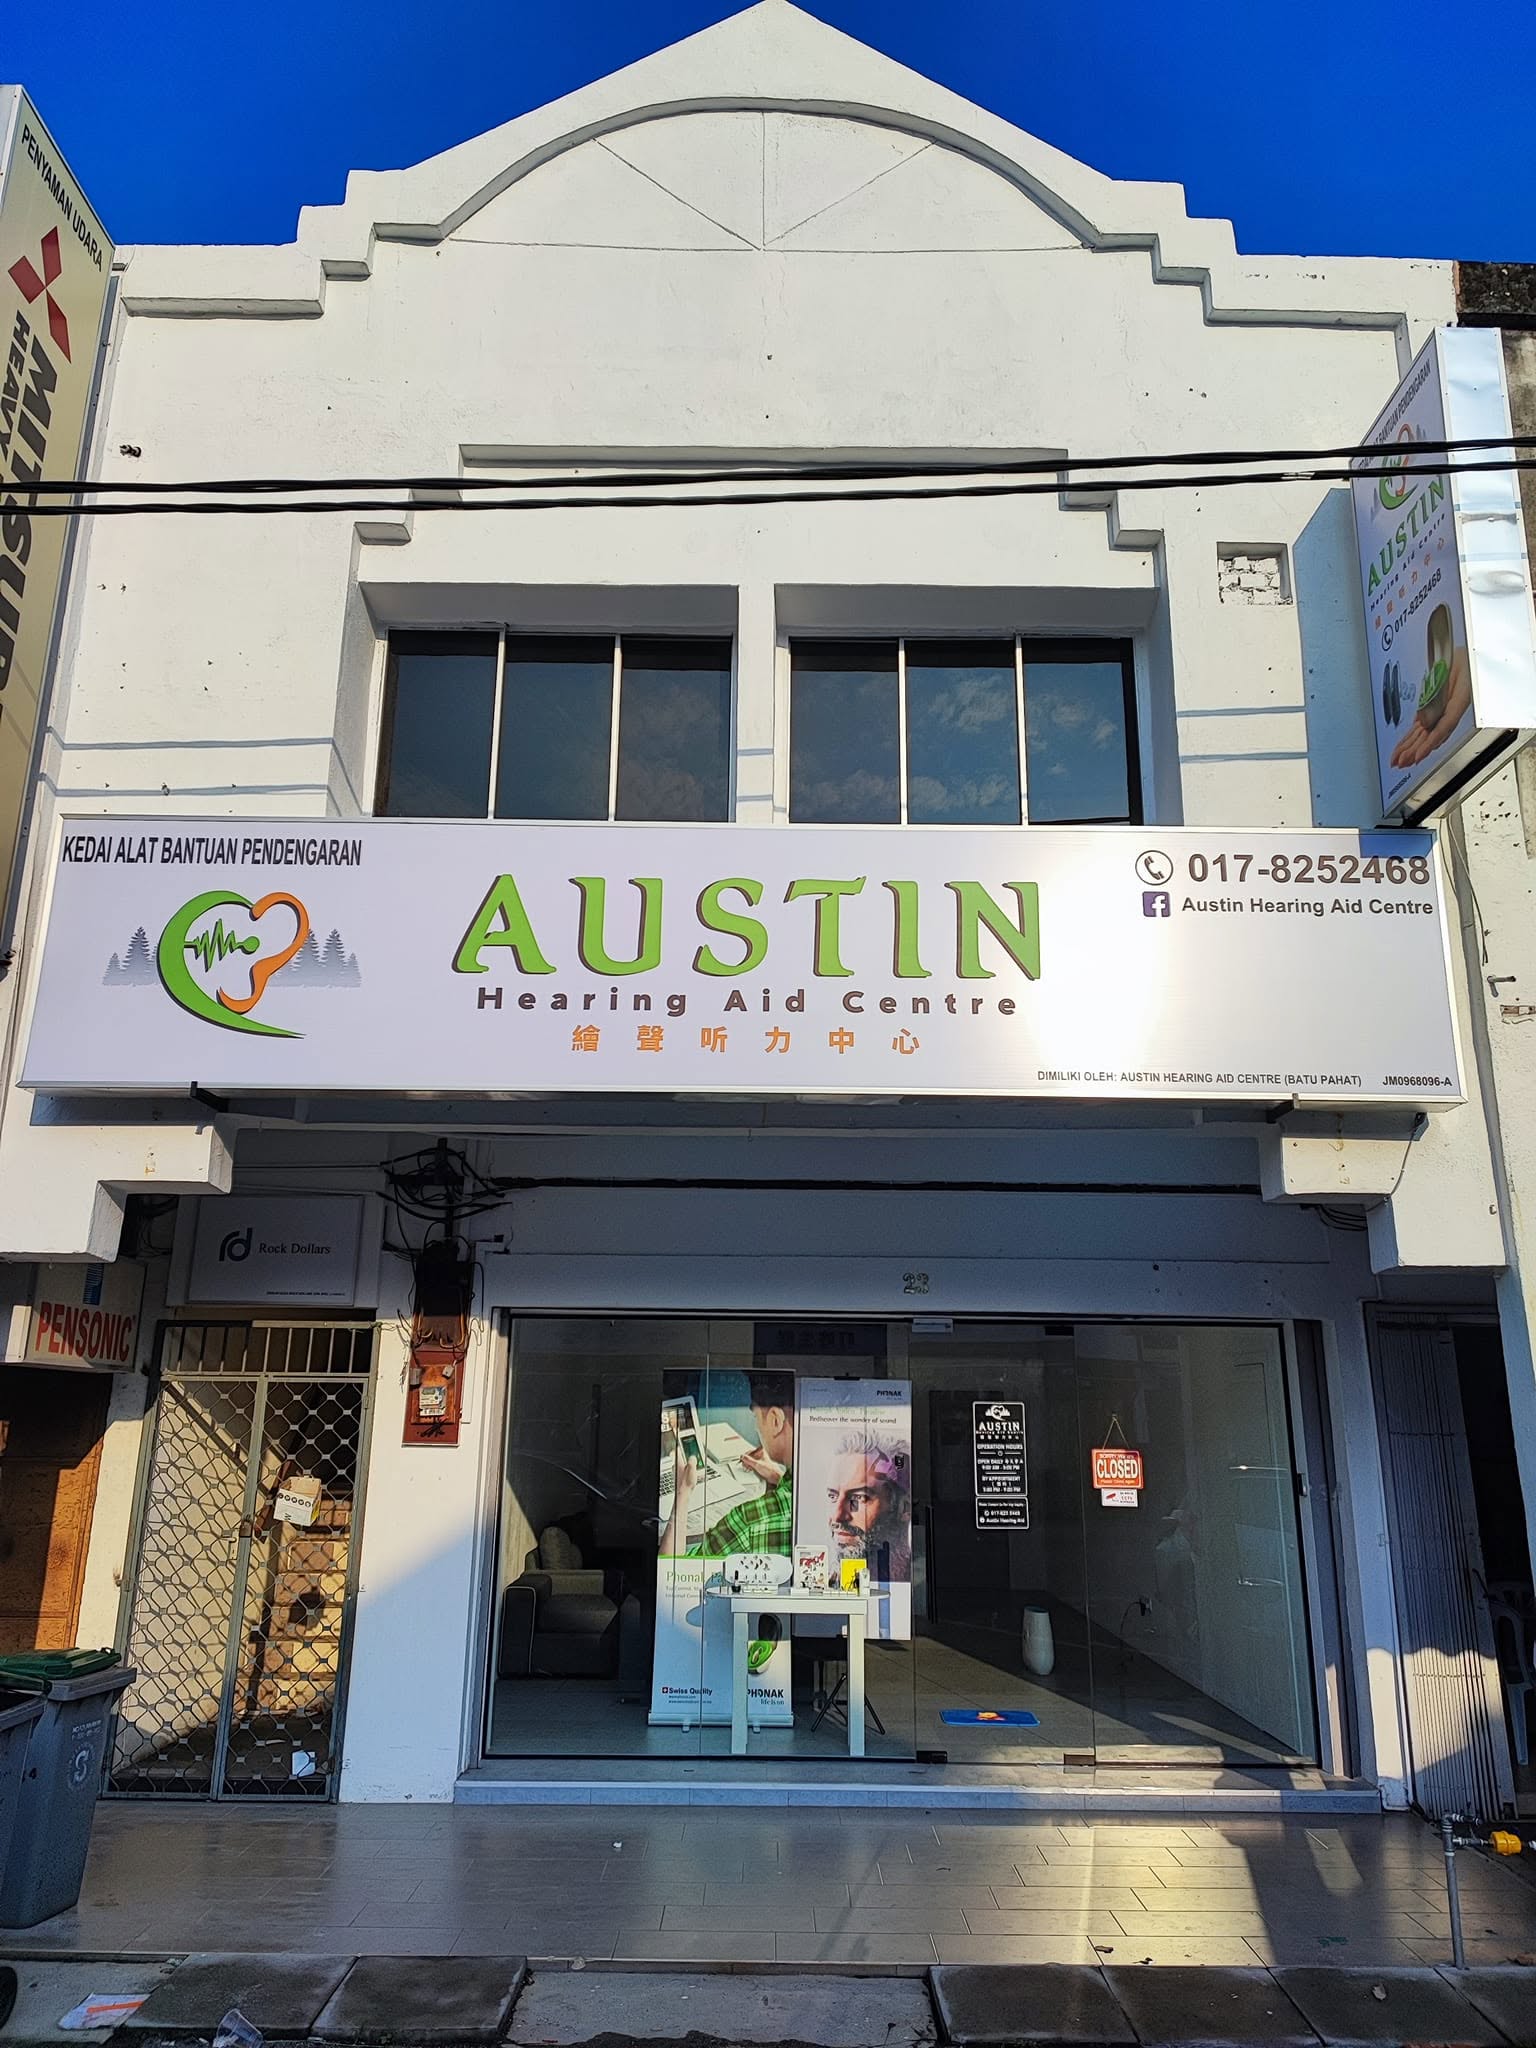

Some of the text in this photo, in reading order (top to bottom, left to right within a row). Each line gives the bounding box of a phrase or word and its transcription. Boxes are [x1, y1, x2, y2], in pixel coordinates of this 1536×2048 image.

[22, 124, 103, 273] PENYAMAN UDARA
[1367, 475, 1445, 597] AUSTIN
[1370, 513, 1446, 612] Hearing Aid Centre
[1394, 567, 1442, 633] 017-8252468
[62, 835, 362, 866] KEDAI ALAT BANTUAN PENDENGARAN
[1188, 853, 1430, 885] 017-8252468
[1182, 897, 1433, 917] Austin Hearing Aid Centre
[451, 873, 1041, 981] AUSTIN
[477, 987, 1016, 1018] Hearing Aid Centre
[1037, 1070, 1362, 1087] DIMILIKI OLEH: AUSTIN HEARING AID CENTRE (BATU PAHAT)
[1382, 1075, 1453, 1087] JM0968096-A
[259, 1242, 331, 1255] Rock Dollars
[903, 1272, 929, 1294] 23
[35, 1301, 132, 1362] PENSONIC
[876, 1389, 902, 1397] PHONAK
[979, 1421, 1020, 1432] AUSTIN
[1096, 1458, 1139, 1479] CLOSED
[669, 1687, 688, 1695] Swiss
